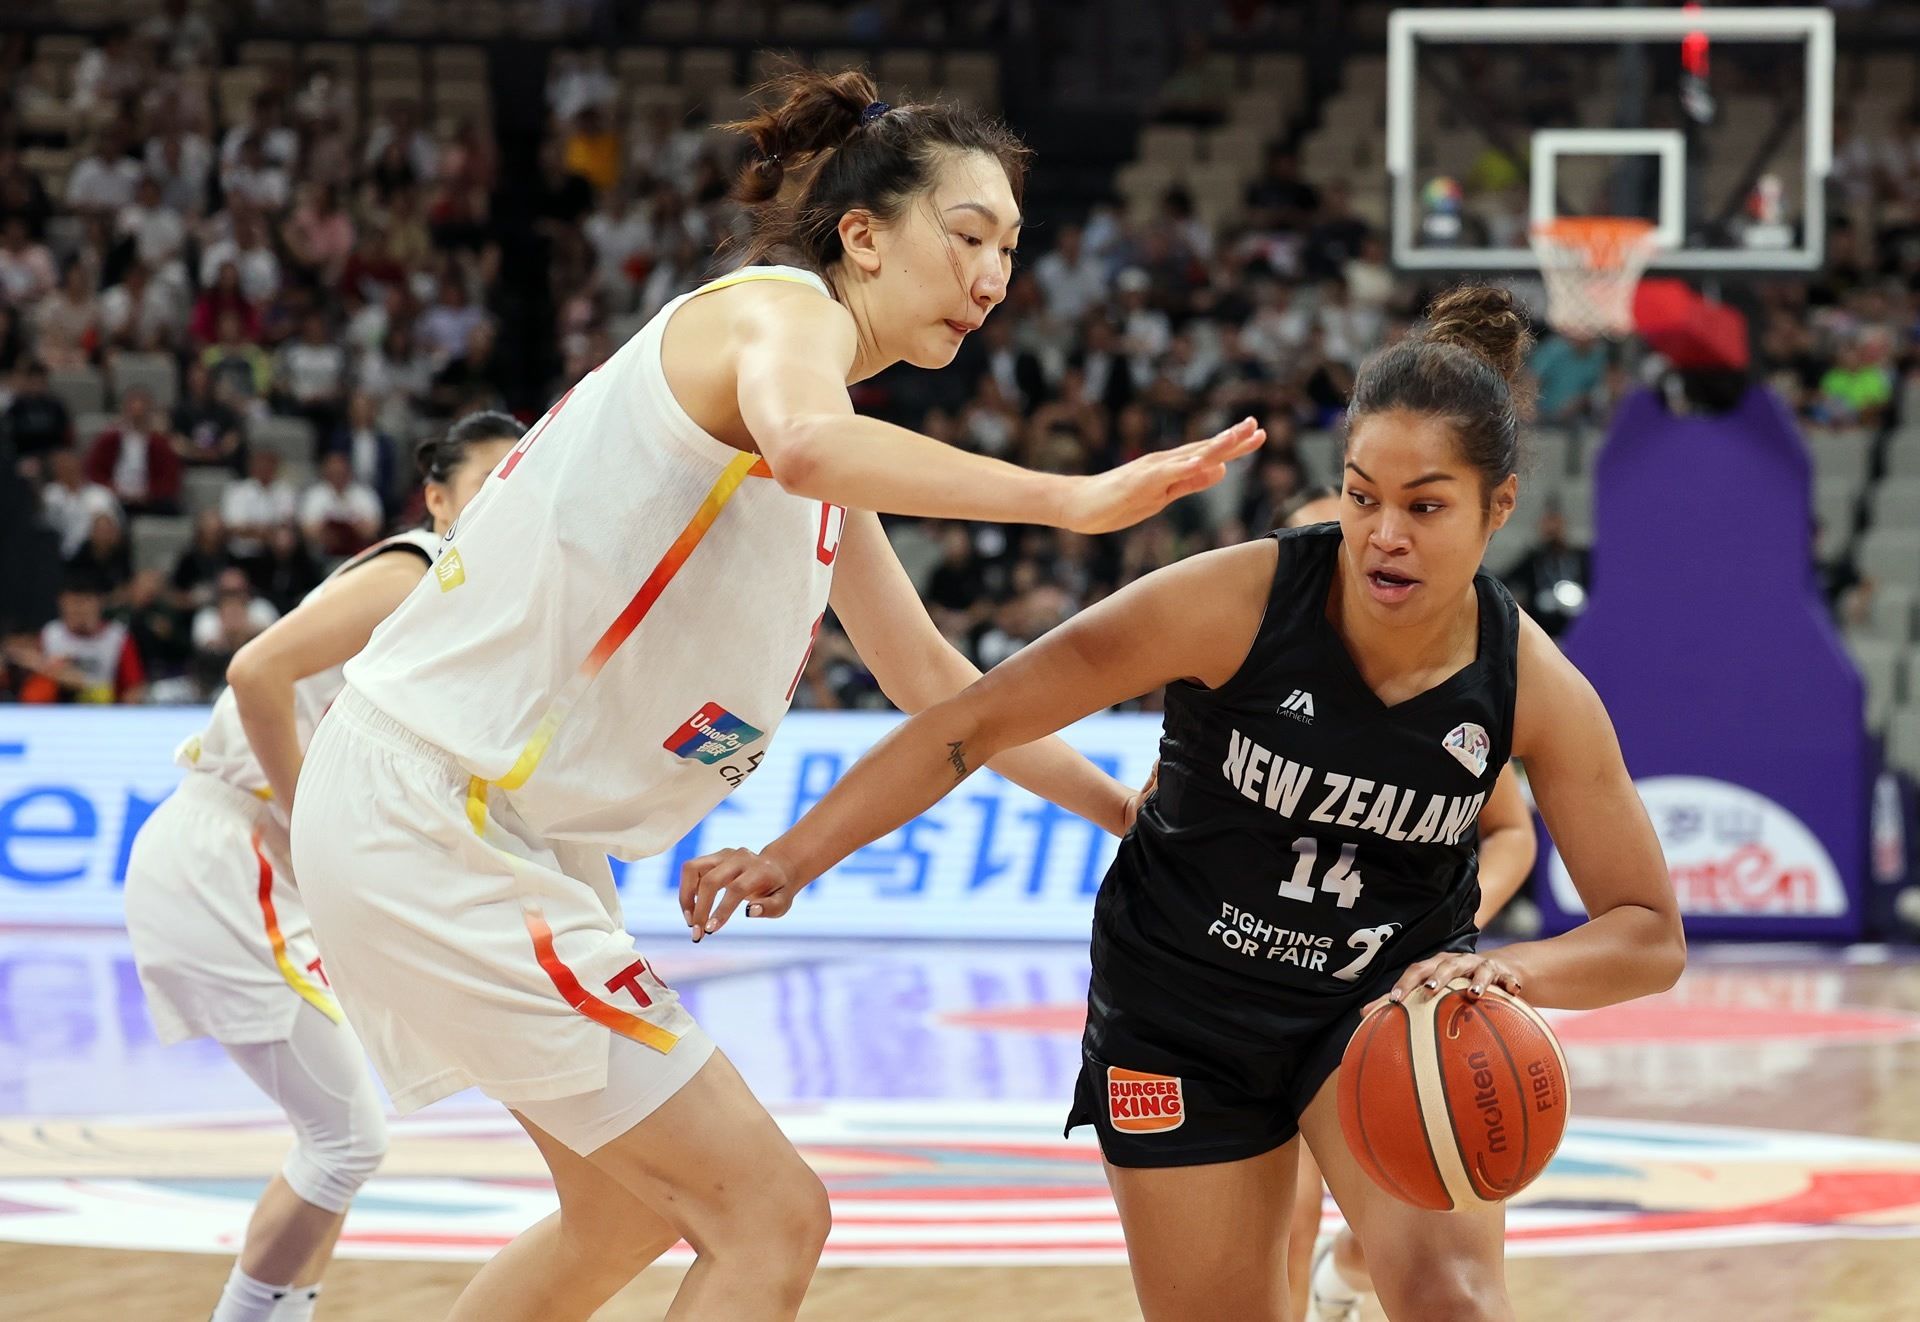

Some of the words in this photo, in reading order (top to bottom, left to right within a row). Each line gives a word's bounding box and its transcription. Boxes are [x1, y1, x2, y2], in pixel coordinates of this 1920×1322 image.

[689, 713, 745, 752] UnionPay
[1222, 728, 1314, 819] NEW
[1308, 772, 1486, 846] ZEALAND
[1277, 837, 1364, 909] 14
[1207, 919, 1260, 957] FOR
[1266, 946, 1328, 972] FAIR
[1221, 901, 1334, 949] FIGHTING
[1110, 1082, 1179, 1097] BURGER
[1111, 1095, 1182, 1118] KING
[1468, 1050, 1508, 1154] molten
[1527, 1060, 1552, 1113] FIBA
